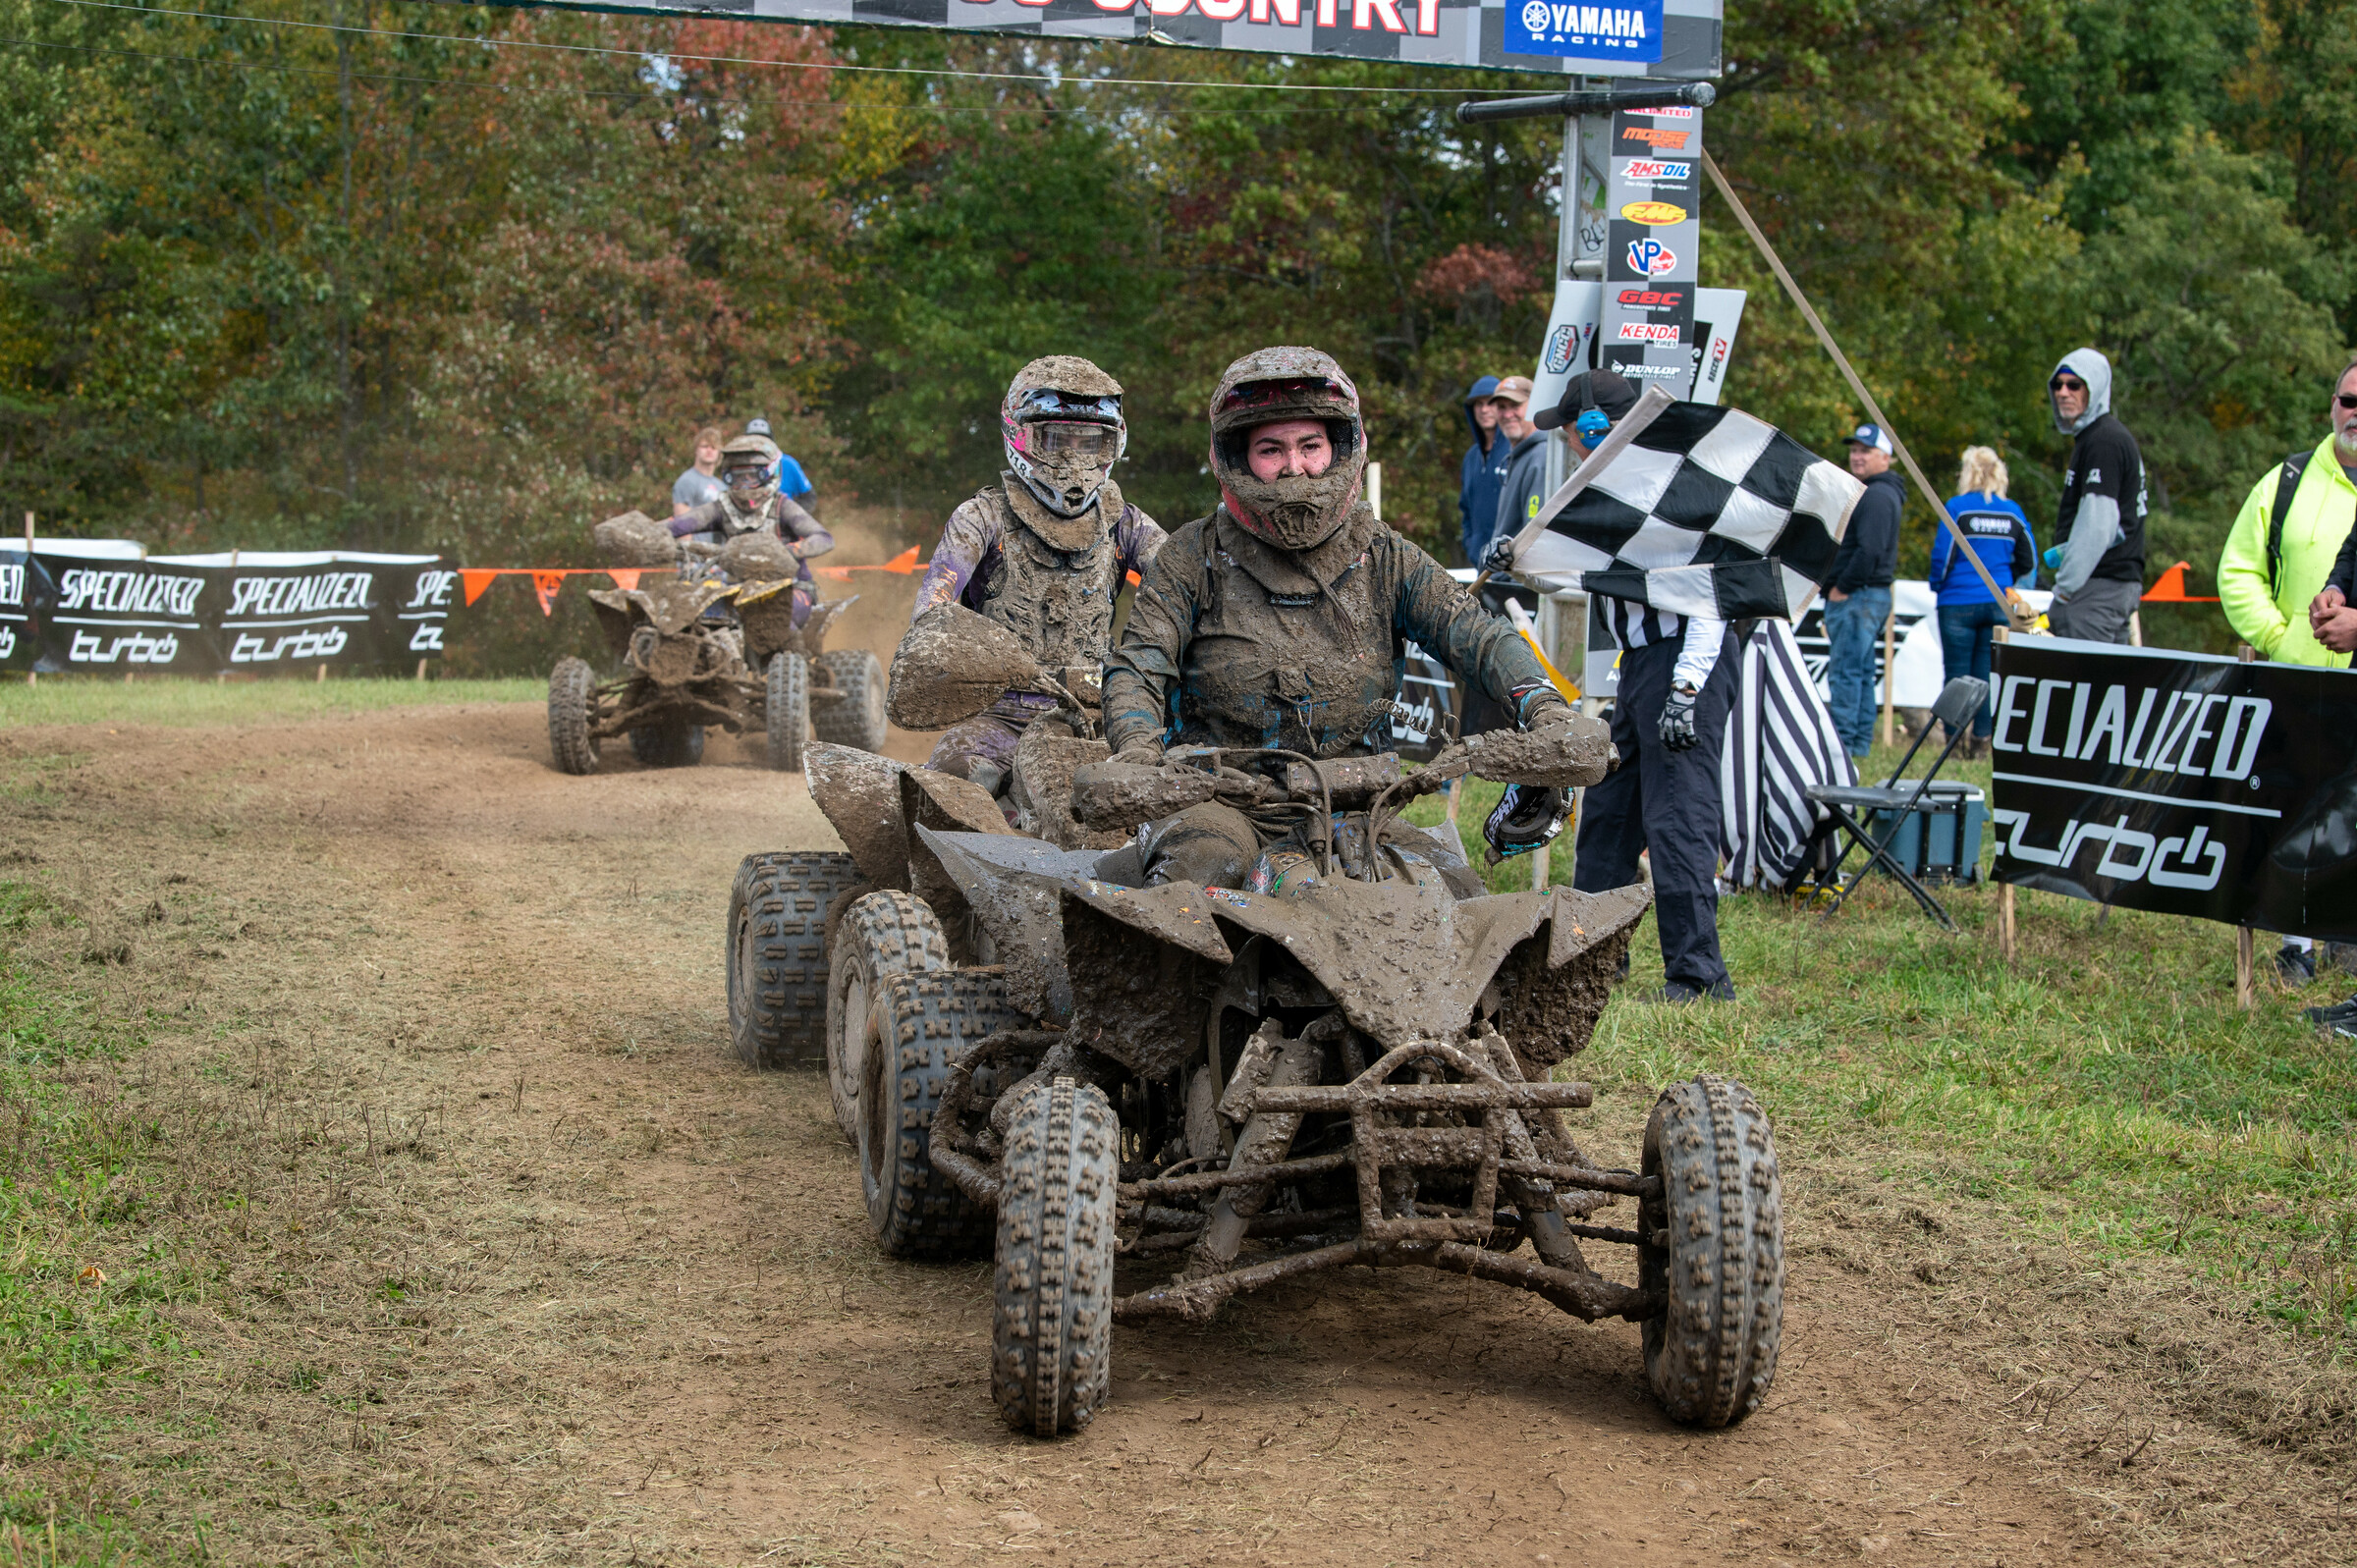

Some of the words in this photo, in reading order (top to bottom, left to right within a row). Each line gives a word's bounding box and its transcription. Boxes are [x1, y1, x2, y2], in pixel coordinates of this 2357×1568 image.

[1551, 4, 1646, 38] YAMAHA
[1531, 32, 1639, 48] RACING
[1622, 127, 1691, 142] MOOSE
[1626, 161, 1688, 178] AMSOIL
[1622, 204, 1687, 221] FMF
[1631, 241, 1662, 272] VP
[1617, 290, 1682, 305] GBC
[1620, 324, 1678, 340] KENDA
[1553, 327, 1572, 371] GNCC
[1623, 363, 1681, 376] DUNLOP
[1009, 448, 1027, 476] 718
[58, 568, 205, 617] SPECIALIZED
[225, 572, 373, 616] SPECIALIZED
[69, 629, 180, 664] turbo
[230, 625, 349, 663] turbo
